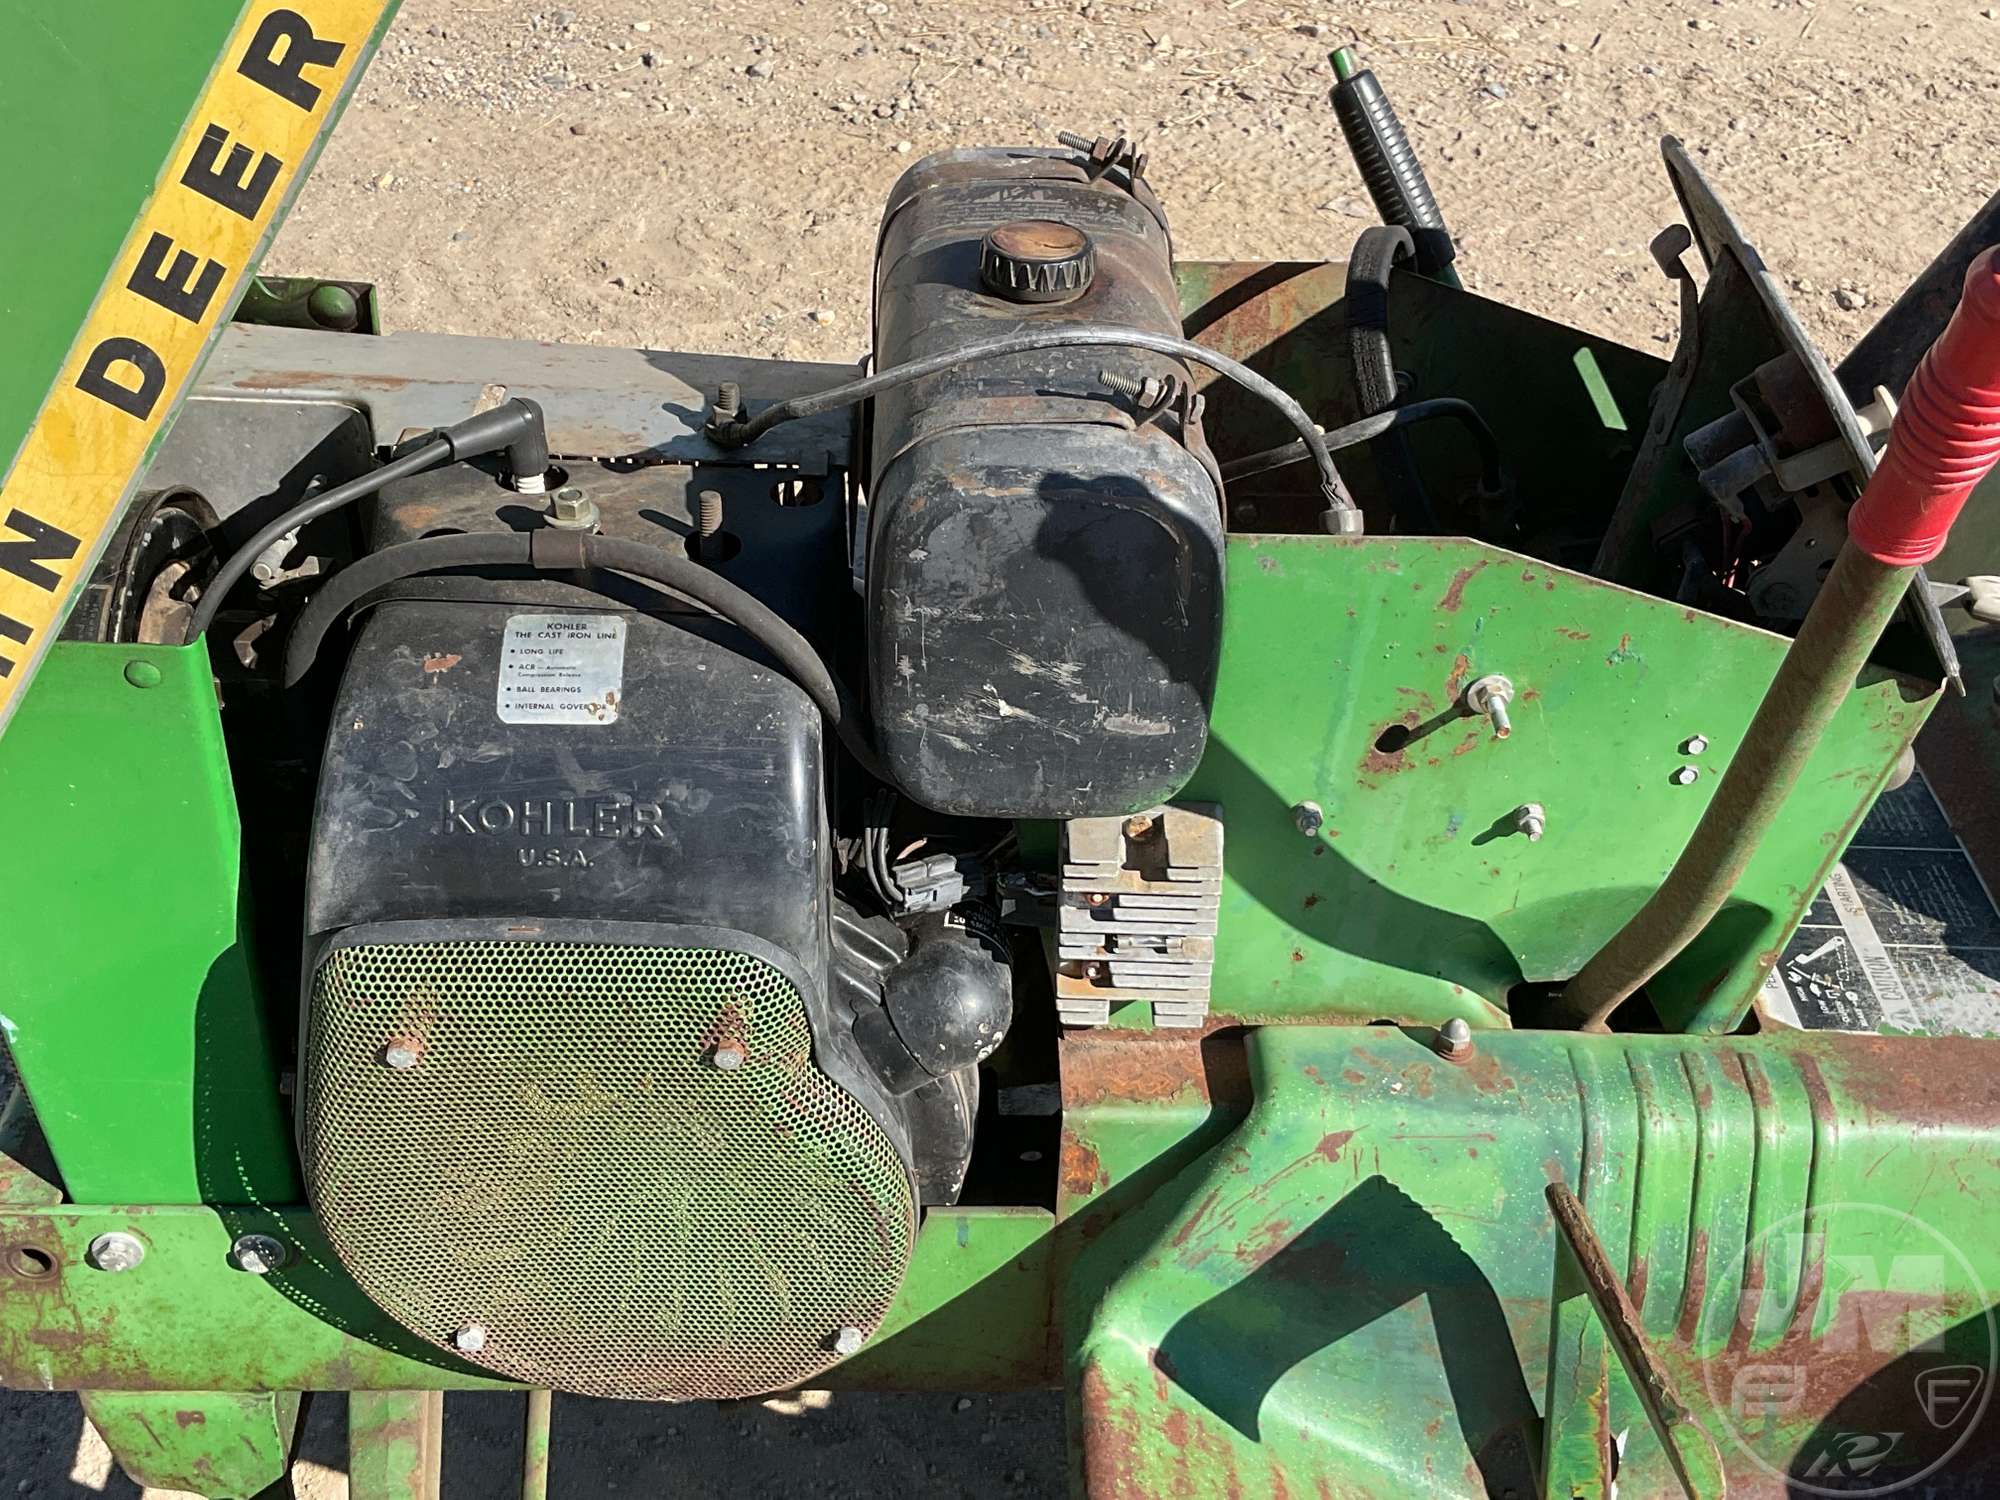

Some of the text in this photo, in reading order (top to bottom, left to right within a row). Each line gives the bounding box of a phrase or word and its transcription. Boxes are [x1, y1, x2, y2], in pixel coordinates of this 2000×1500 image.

[547, 623, 588, 631] KOHLER
[515, 631, 532, 639] THE
[537, 631, 561, 639] CAST
[596, 632, 617, 640] LINE
[559, 703, 607, 711] GOVEROR
[443, 798, 665, 839] KOHLER
[517, 848, 595, 867] U.S.A.
[1863, 956, 1902, 1001] CAUTION
